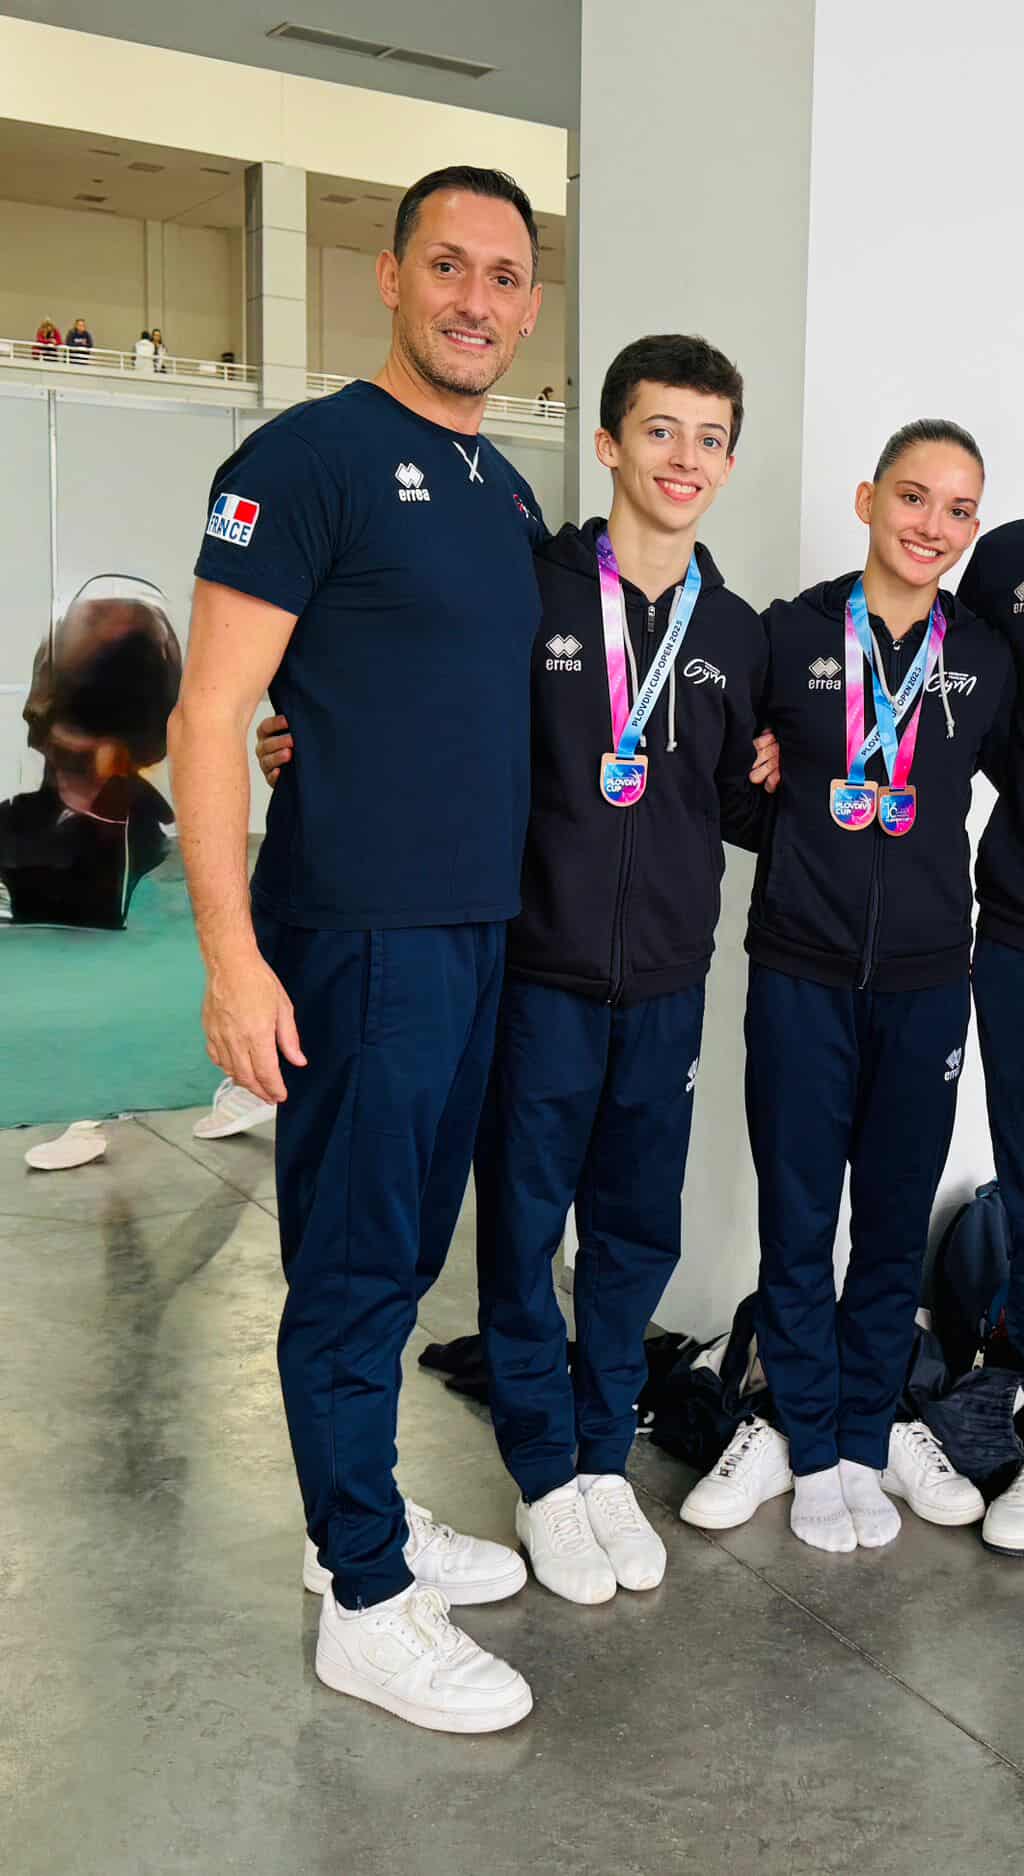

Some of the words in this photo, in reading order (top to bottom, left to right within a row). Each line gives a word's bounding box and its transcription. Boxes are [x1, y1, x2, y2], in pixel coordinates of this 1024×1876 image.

[398, 488, 431, 503] errea
[208, 514, 251, 543] FRANCE
[545, 658, 582, 672] errea
[683, 658, 727, 689] Gym
[632, 688, 655, 727] PLOVDIV
[649, 669, 664, 688] CUP
[658, 642, 674, 668] OPEN
[808, 679, 842, 690] errea
[898, 685, 912, 706] OPEN
[907, 667, 922, 687] 2025
[925, 671, 977, 697] Gym
[606, 785, 622, 793] CUP
[835, 808, 852, 816] CUP
